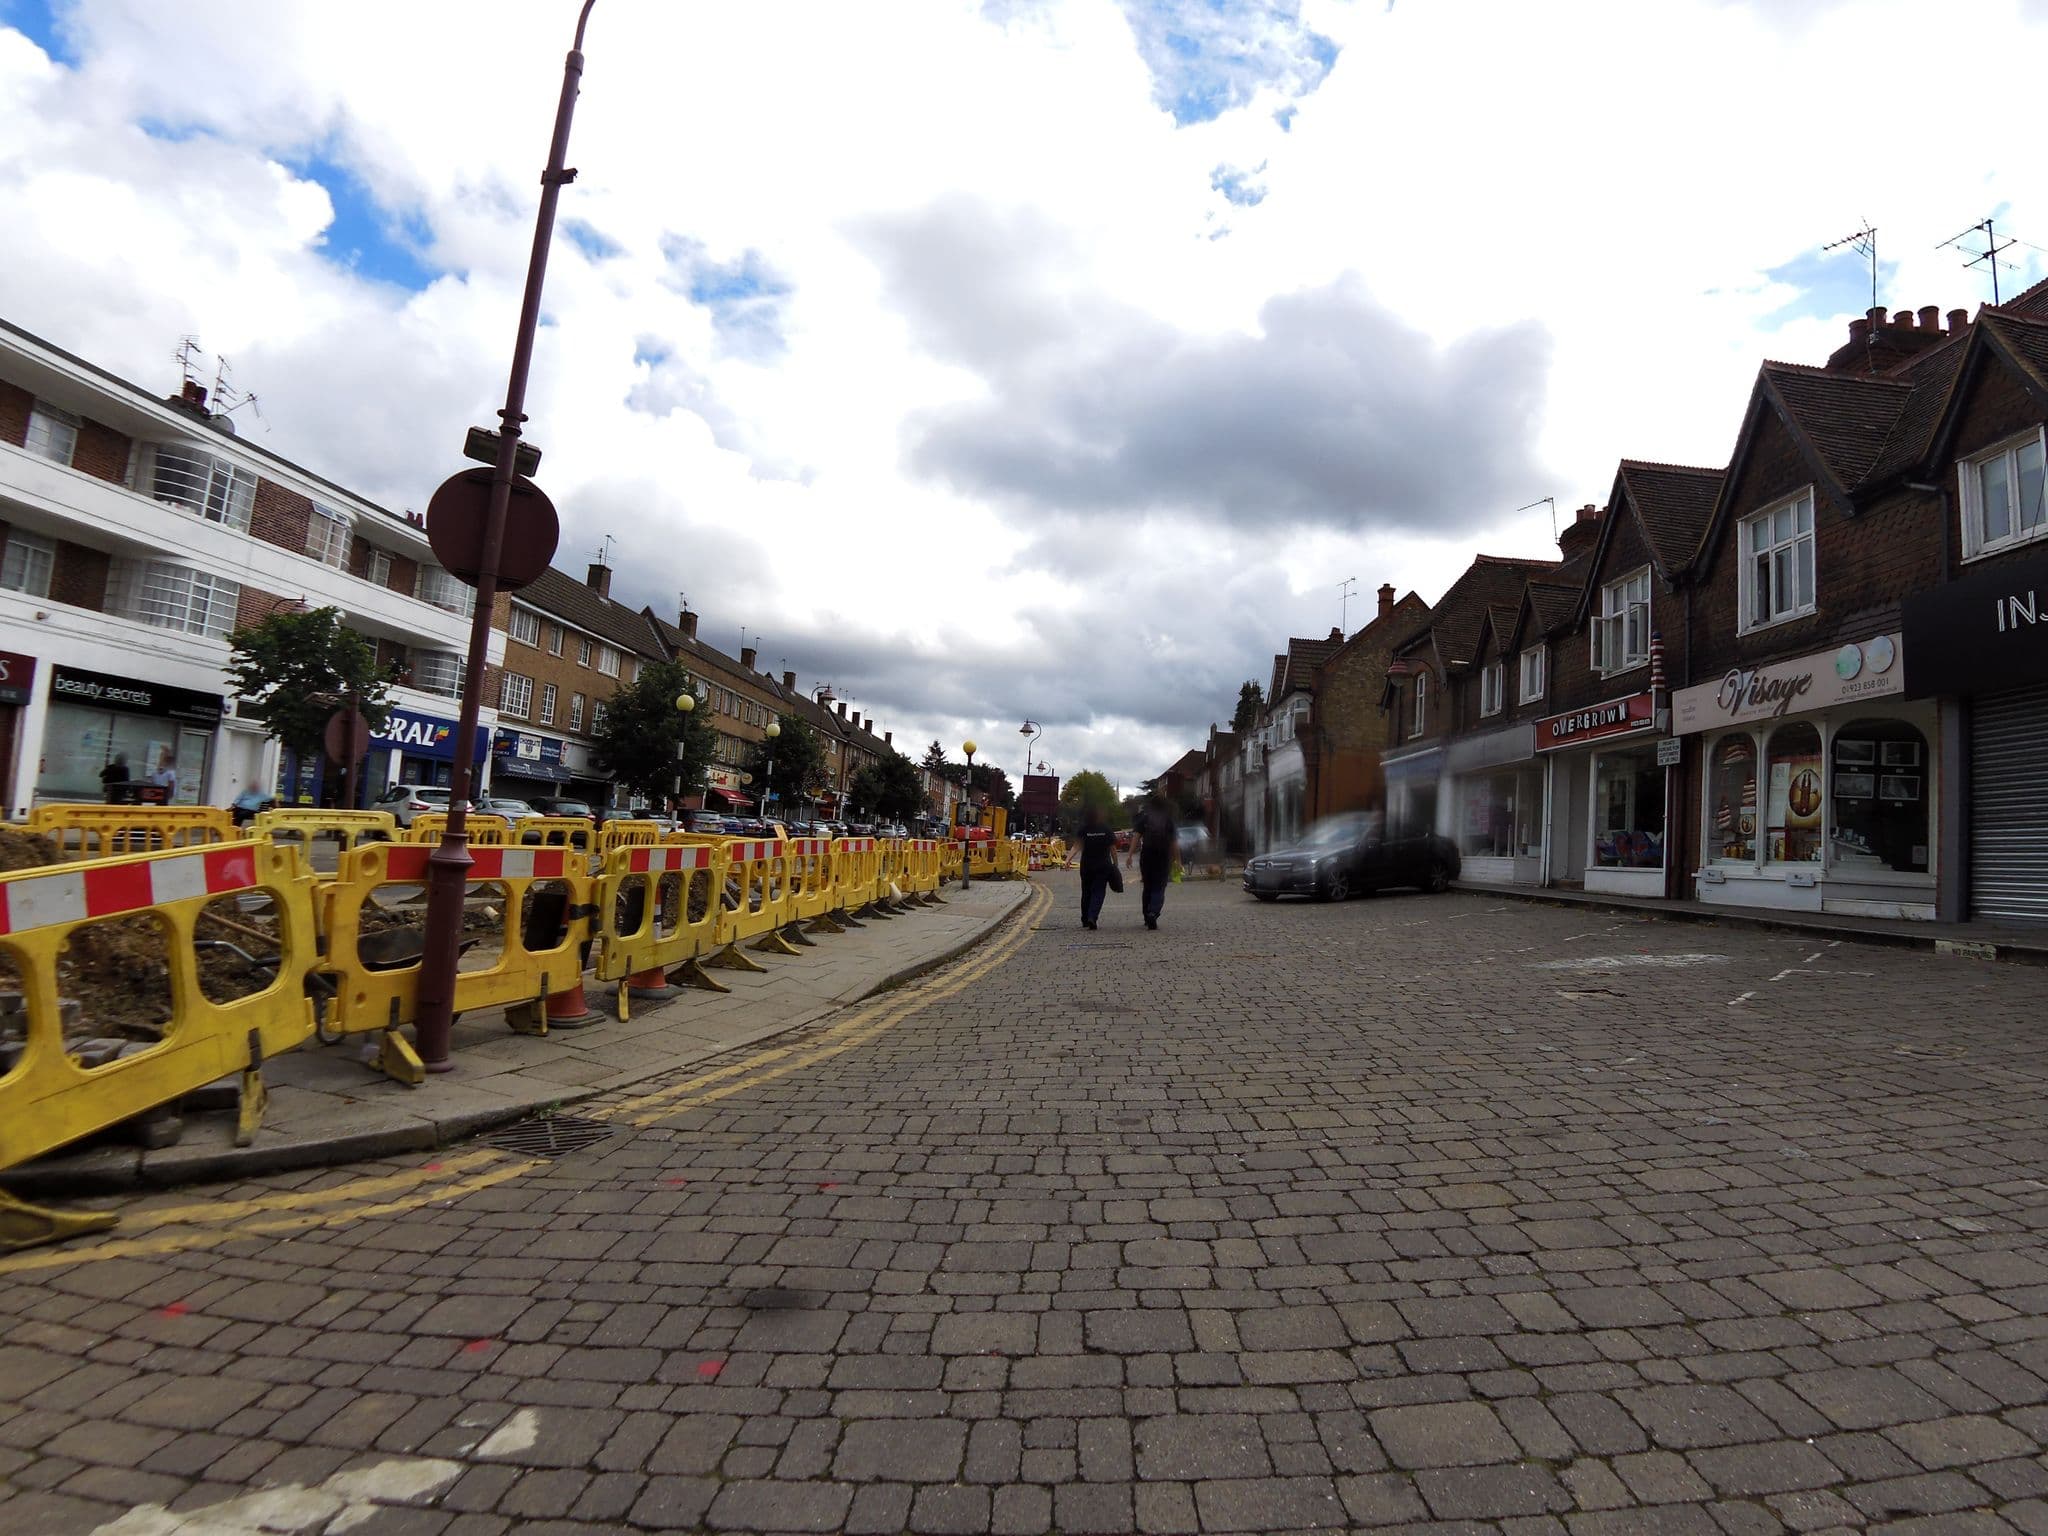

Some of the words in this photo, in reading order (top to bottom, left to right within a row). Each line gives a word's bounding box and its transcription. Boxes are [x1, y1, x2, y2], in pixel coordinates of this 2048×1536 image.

[55, 674, 103, 699] beauty
[105, 687, 152, 705] secrets
[1717, 668, 1812, 719] Visage
[1552, 702, 1627, 736] OVERGROWN
